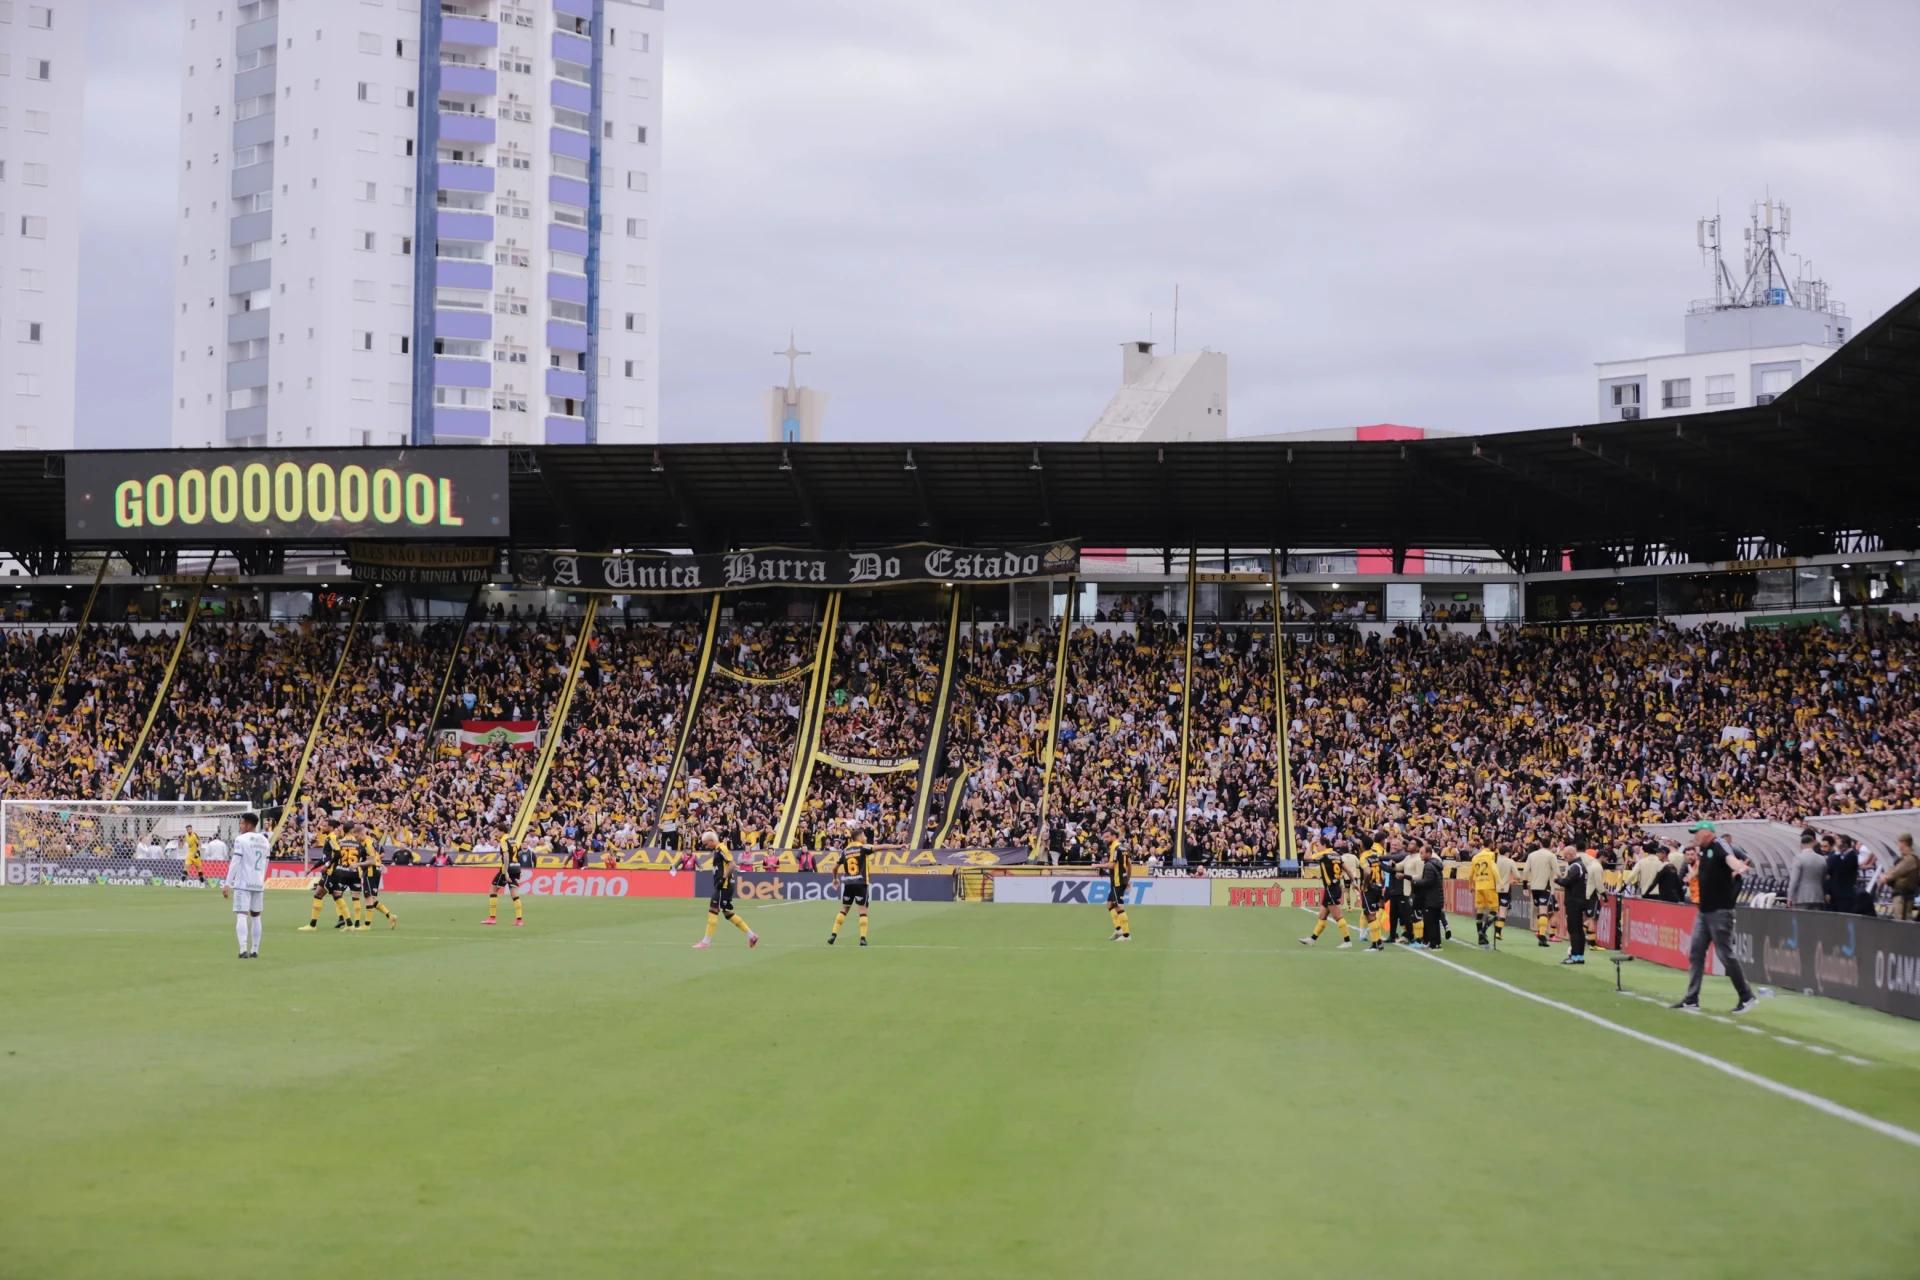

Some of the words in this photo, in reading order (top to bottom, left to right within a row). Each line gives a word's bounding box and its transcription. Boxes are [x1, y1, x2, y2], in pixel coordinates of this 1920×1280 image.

[115, 462, 464, 528] GOOOOOOOOOL
[354, 565, 378, 580] QUE
[380, 567, 406, 582] ISSO
[410, 567, 417, 583] É
[420, 568, 457, 583] MINHA
[462, 567, 489, 582] VIDA
[552, 556, 582, 587] A
[722, 552, 827, 588] Barra
[848, 552, 901, 583] Do
[924, 548, 1039, 579] Estado
[254, 850, 263, 871] 2
[846, 857, 860, 876] 6
[1475, 860, 1489, 877] 22
[1153, 867, 1192, 878] ALGUN
[1205, 868, 1239, 878] MORES
[1241, 866, 1278, 879] MATAM
[1051, 880, 1153, 905] 1XBT
